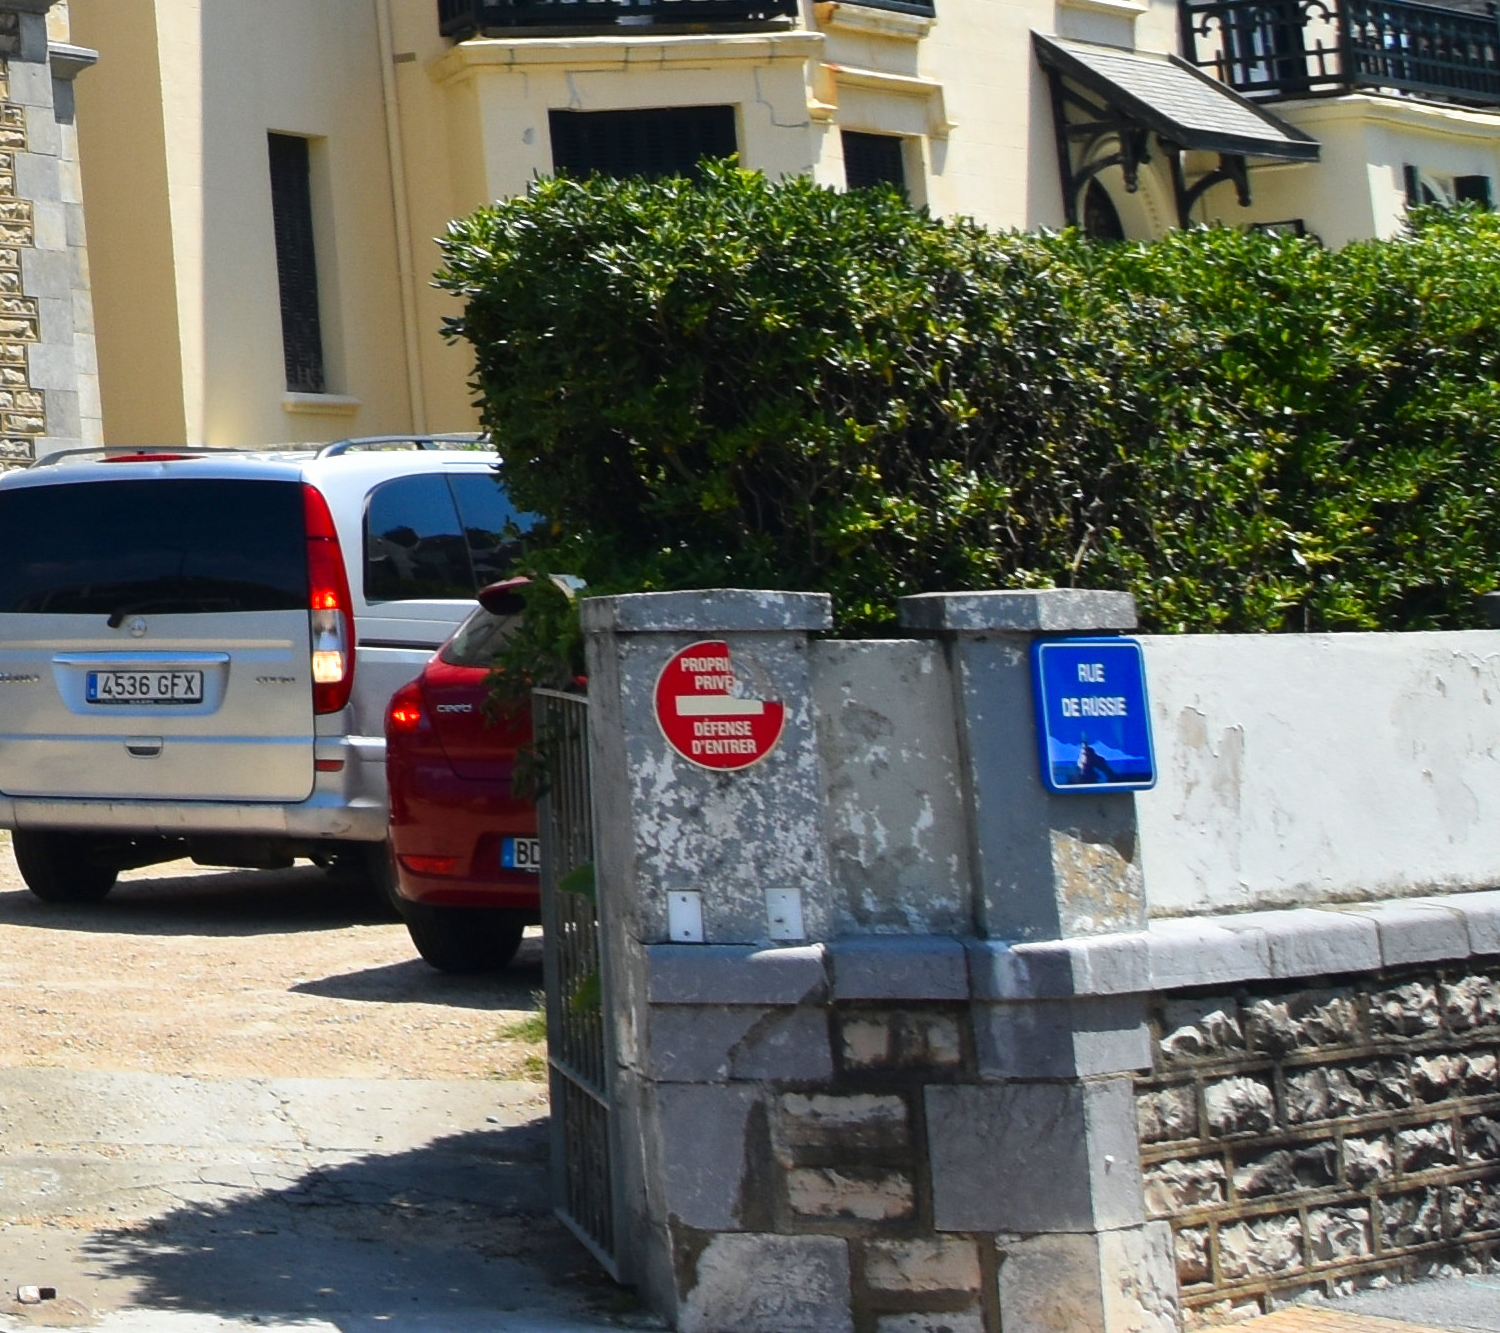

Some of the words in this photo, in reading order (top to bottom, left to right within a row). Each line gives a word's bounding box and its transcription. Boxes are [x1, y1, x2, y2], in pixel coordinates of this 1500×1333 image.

[1077, 663, 1105, 682] RUE
[102, 675, 150, 695] 4536
[157, 674, 195, 695] GFX
[1061, 697, 1080, 717] DE
[1081, 696, 1127, 717] RUSSIE
[693, 718, 753, 736] DÉFENSE
[691, 738, 757, 754] D'ENTRER
